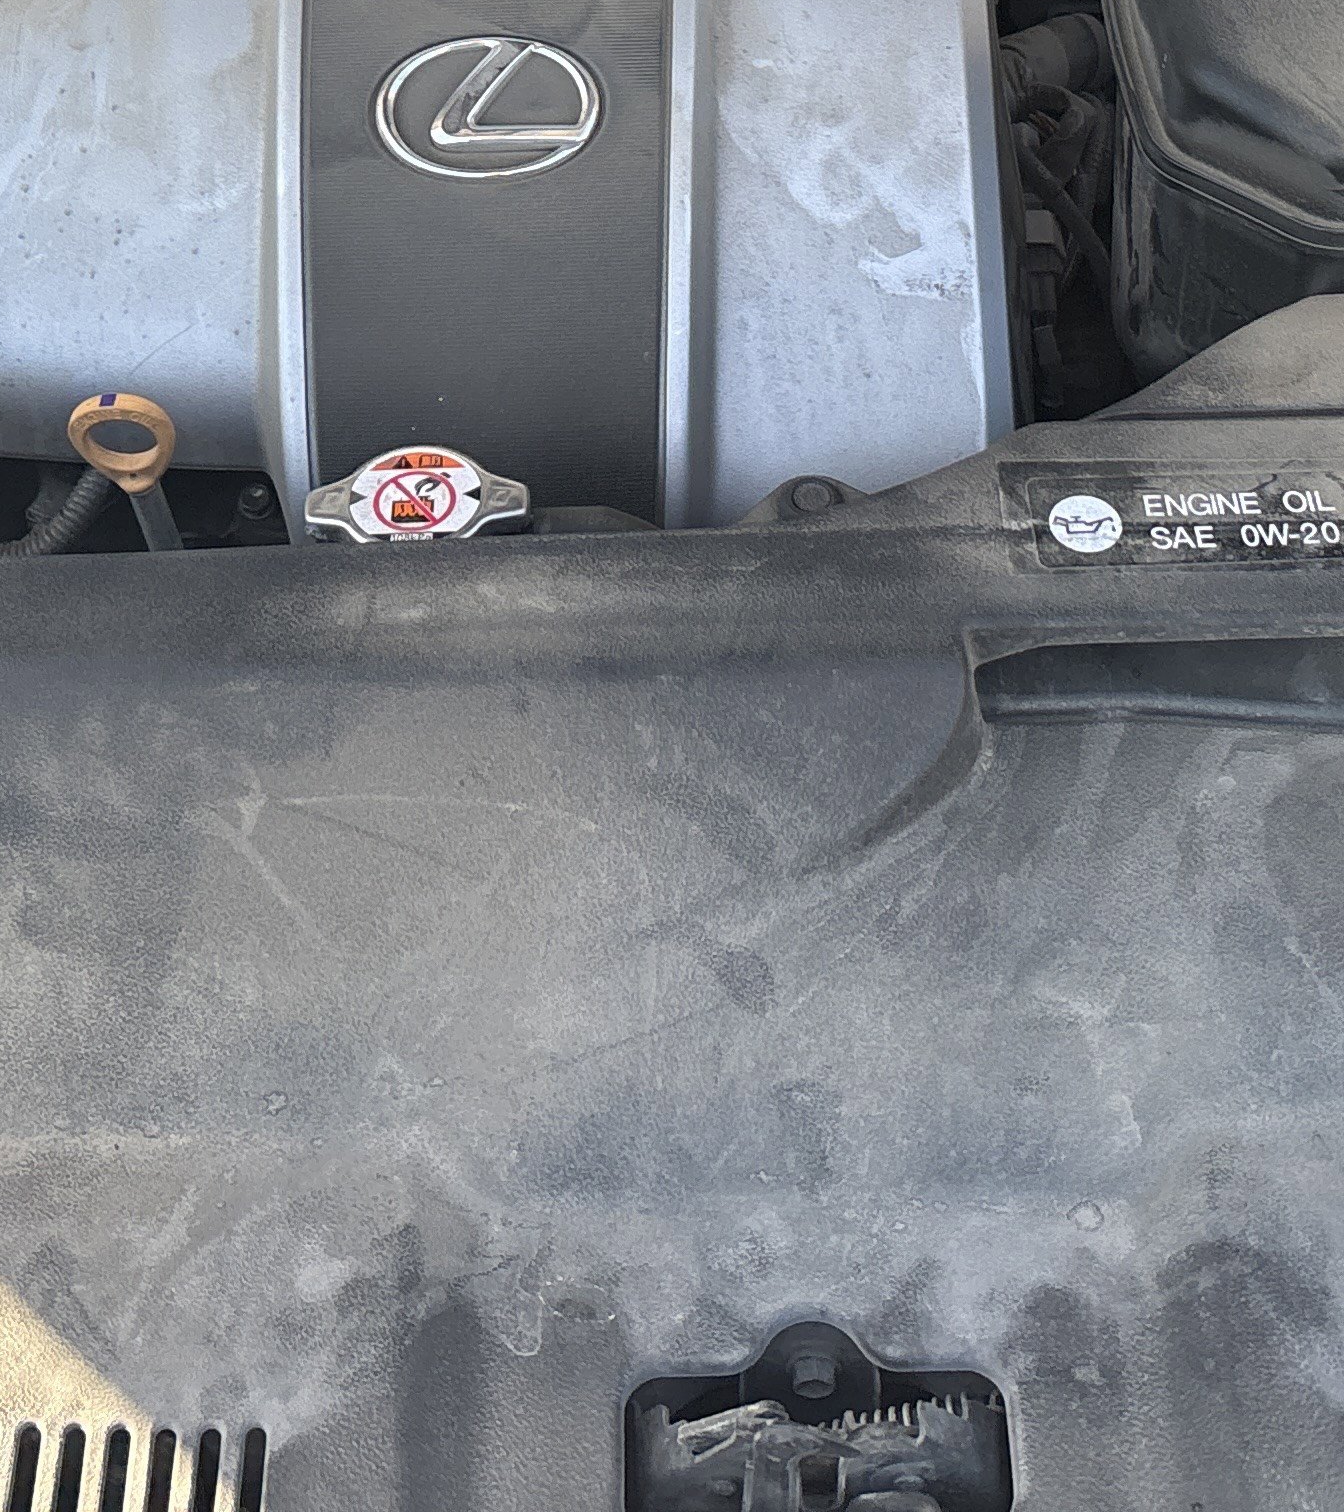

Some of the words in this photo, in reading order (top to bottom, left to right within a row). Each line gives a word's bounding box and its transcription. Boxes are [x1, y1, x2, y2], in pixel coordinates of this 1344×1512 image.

[1142, 491, 1260, 517] ENGINE
[1281, 489, 1336, 512] OIL
[1149, 525, 1218, 550] SAE
[1239, 520, 1342, 548] 0W-20
